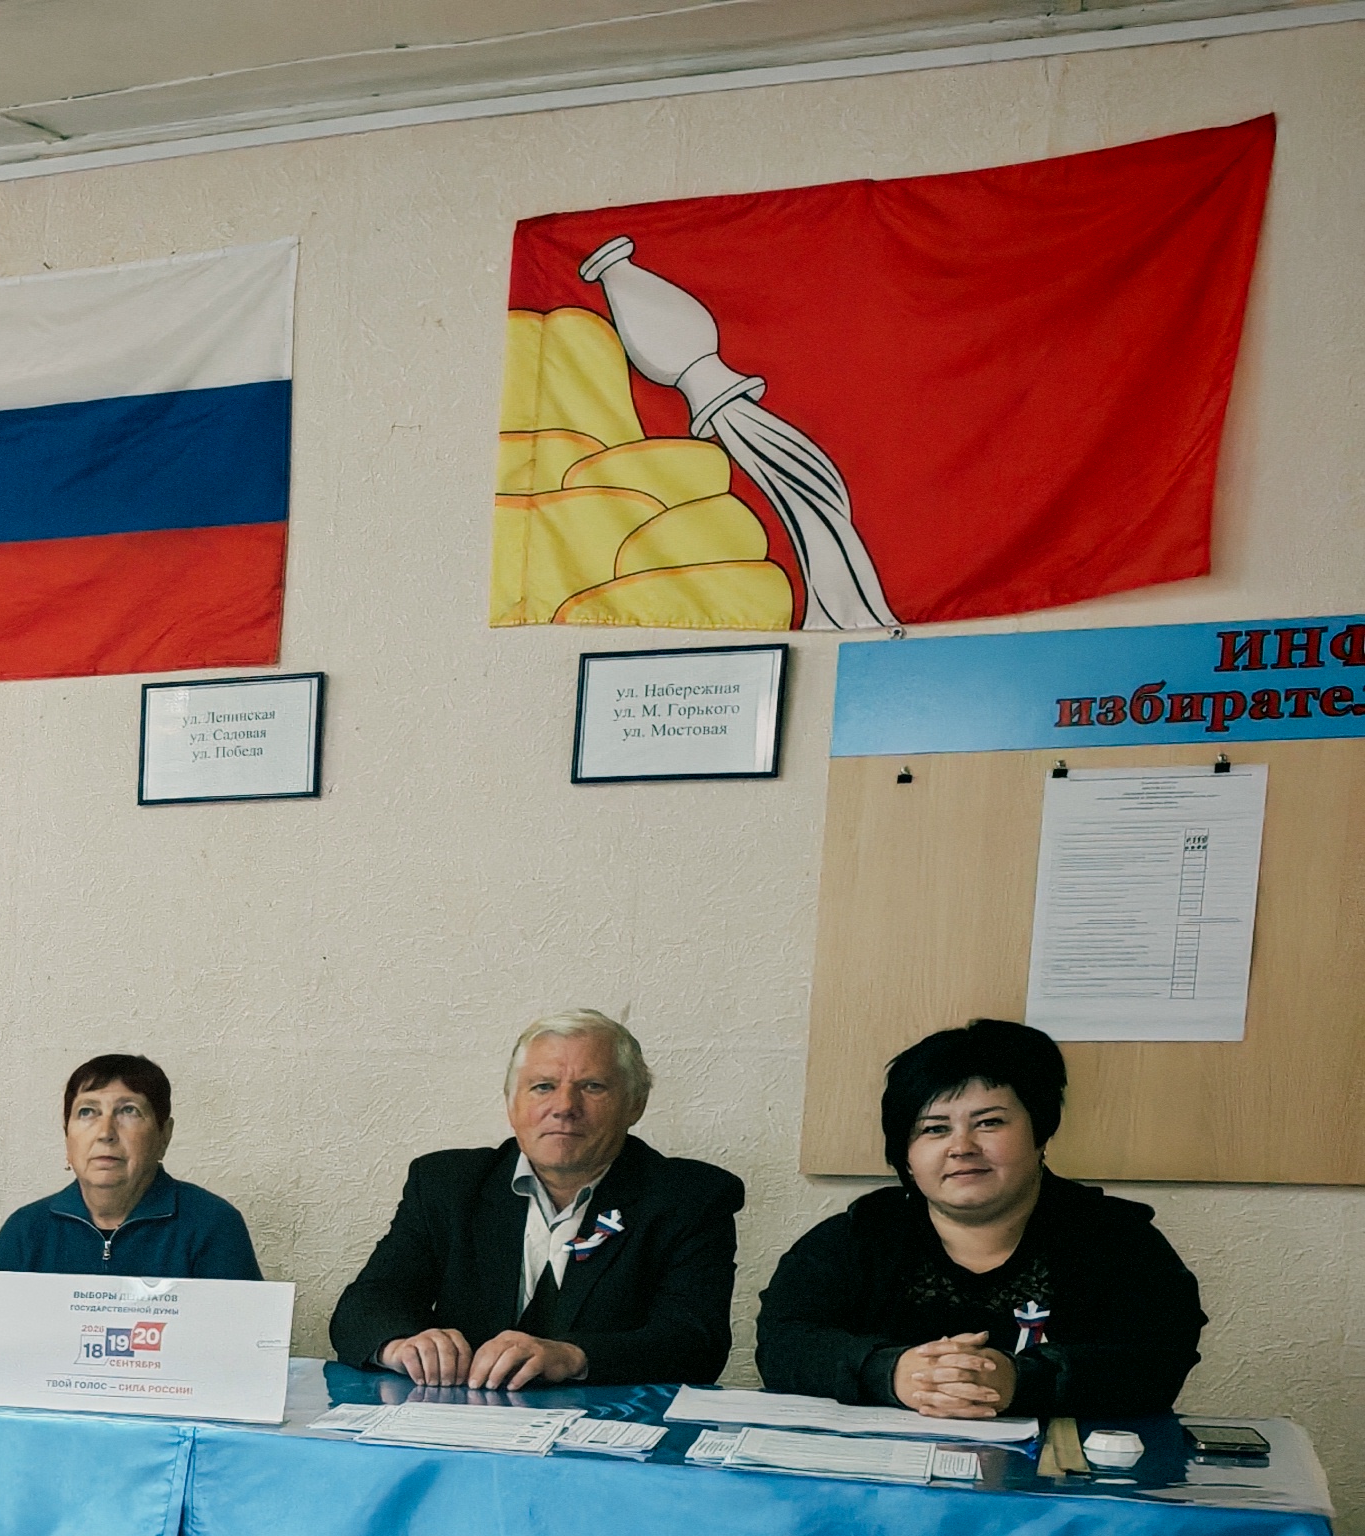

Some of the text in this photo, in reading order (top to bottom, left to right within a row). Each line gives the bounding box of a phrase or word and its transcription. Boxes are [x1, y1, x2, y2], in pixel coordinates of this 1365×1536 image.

[616, 683, 741, 701] ул. Набережная
[613, 703, 740, 722] ул. М. Горького
[1054, 679, 1365, 732] избирате
[182, 710, 276, 728] ул. Ленинская
[190, 729, 267, 745] ул. Садовая
[622, 724, 728, 741] ул. Мостовая
[192, 745, 264, 763] ул. Победа
[73, 1290, 117, 1300] ВЫБОРЫ
[70, 1304, 151, 1315] ГОСУДАРСТВЕННОЙ
[83, 1327, 160, 1358] 18 19 20
[109, 1359, 161, 1369] СЕНТЯБРЯ
[46, 1379, 72, 1389] ТВОЙ
[74, 1380, 107, 1390] ГОЛОС
[119, 1383, 146, 1393] СИЛА
[148, 1385, 193, 1395] РОССИИ!
